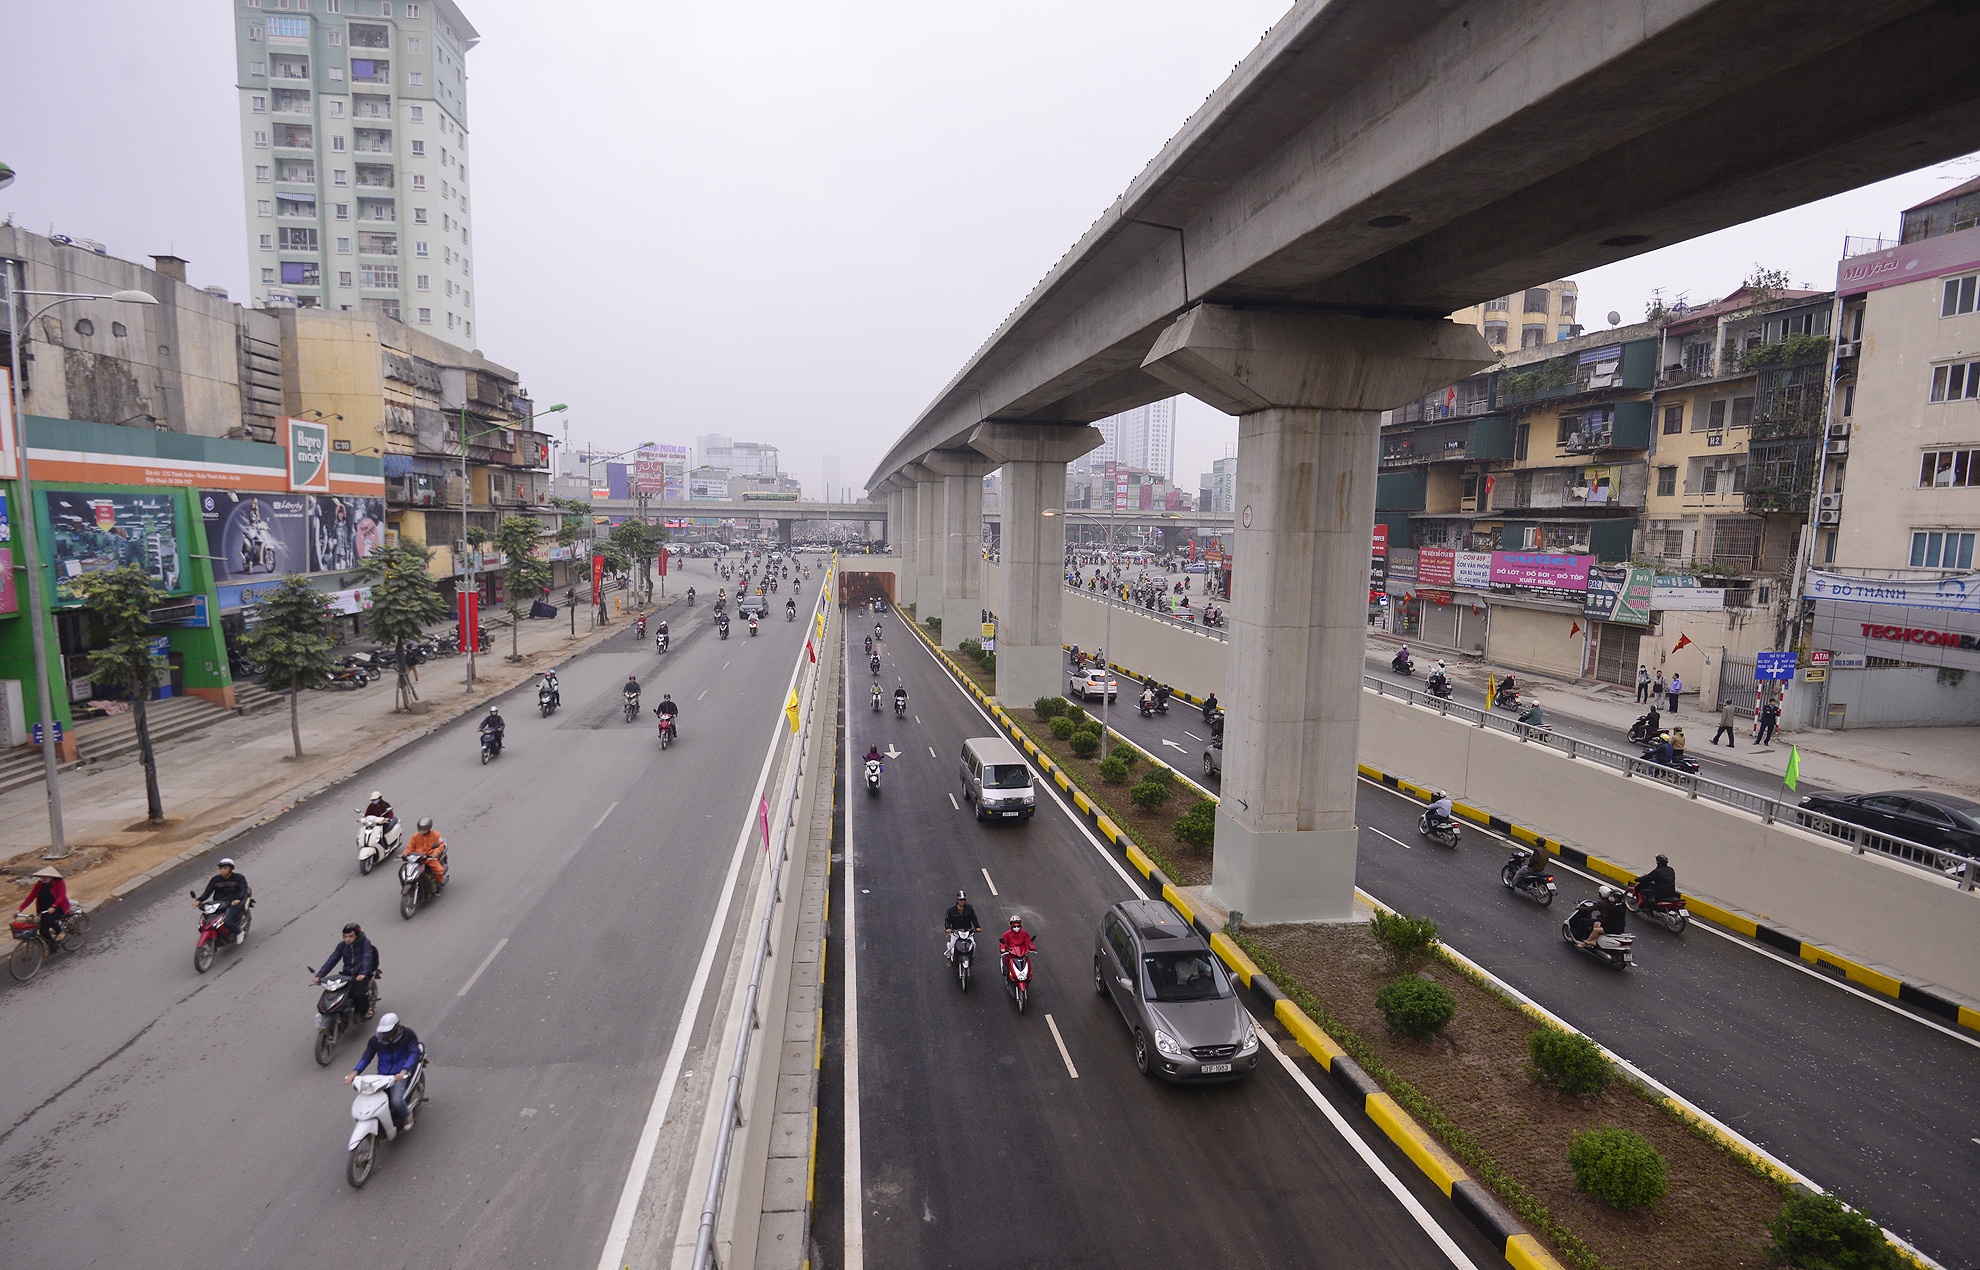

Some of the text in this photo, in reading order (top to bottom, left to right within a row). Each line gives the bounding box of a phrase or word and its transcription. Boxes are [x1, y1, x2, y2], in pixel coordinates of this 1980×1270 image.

[298, 430, 322, 451] Hapro
[334, 441, 350, 450] C10
[1710, 437, 1720, 445] H2
[298, 452, 322, 463] mart
[1225, 474, 1233, 511] angaroo
[1504, 555, 1578, 566] outlet
[1630, 586, 1649, 596] THANH
[1832, 582, 1907, 600] ĐÔ THÀNH
[1628, 599, 1649, 610] NHUNG
